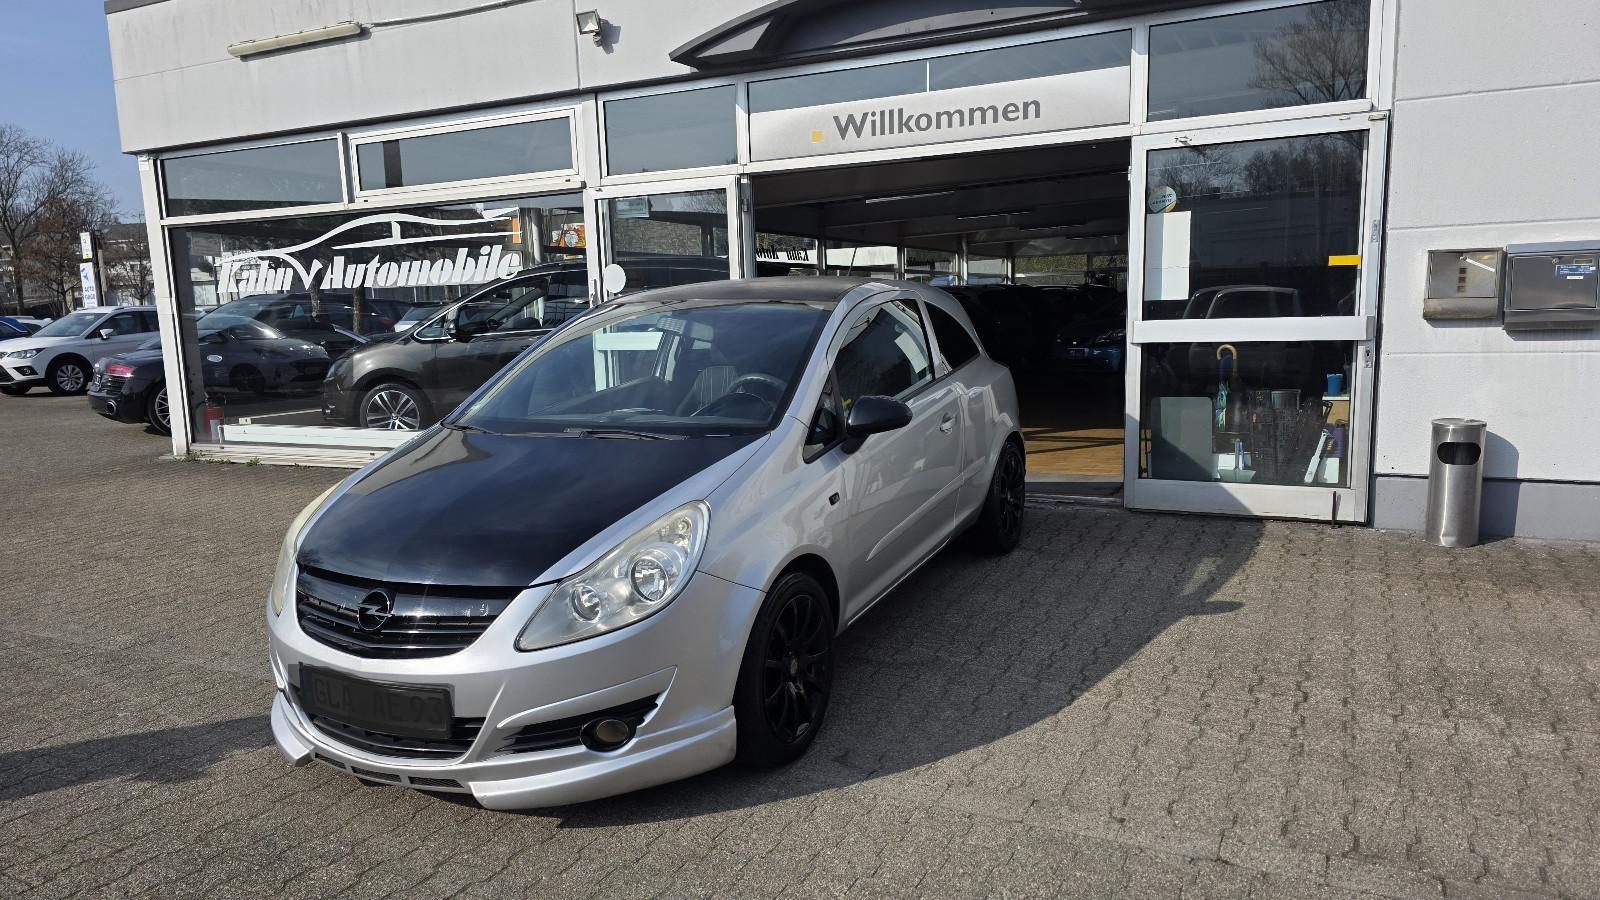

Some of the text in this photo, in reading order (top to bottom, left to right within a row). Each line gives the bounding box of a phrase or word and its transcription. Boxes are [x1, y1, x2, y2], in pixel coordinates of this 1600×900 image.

[833, 99, 1041, 141] Willkommen
[217, 244, 523, 293] Kahn Automobile
